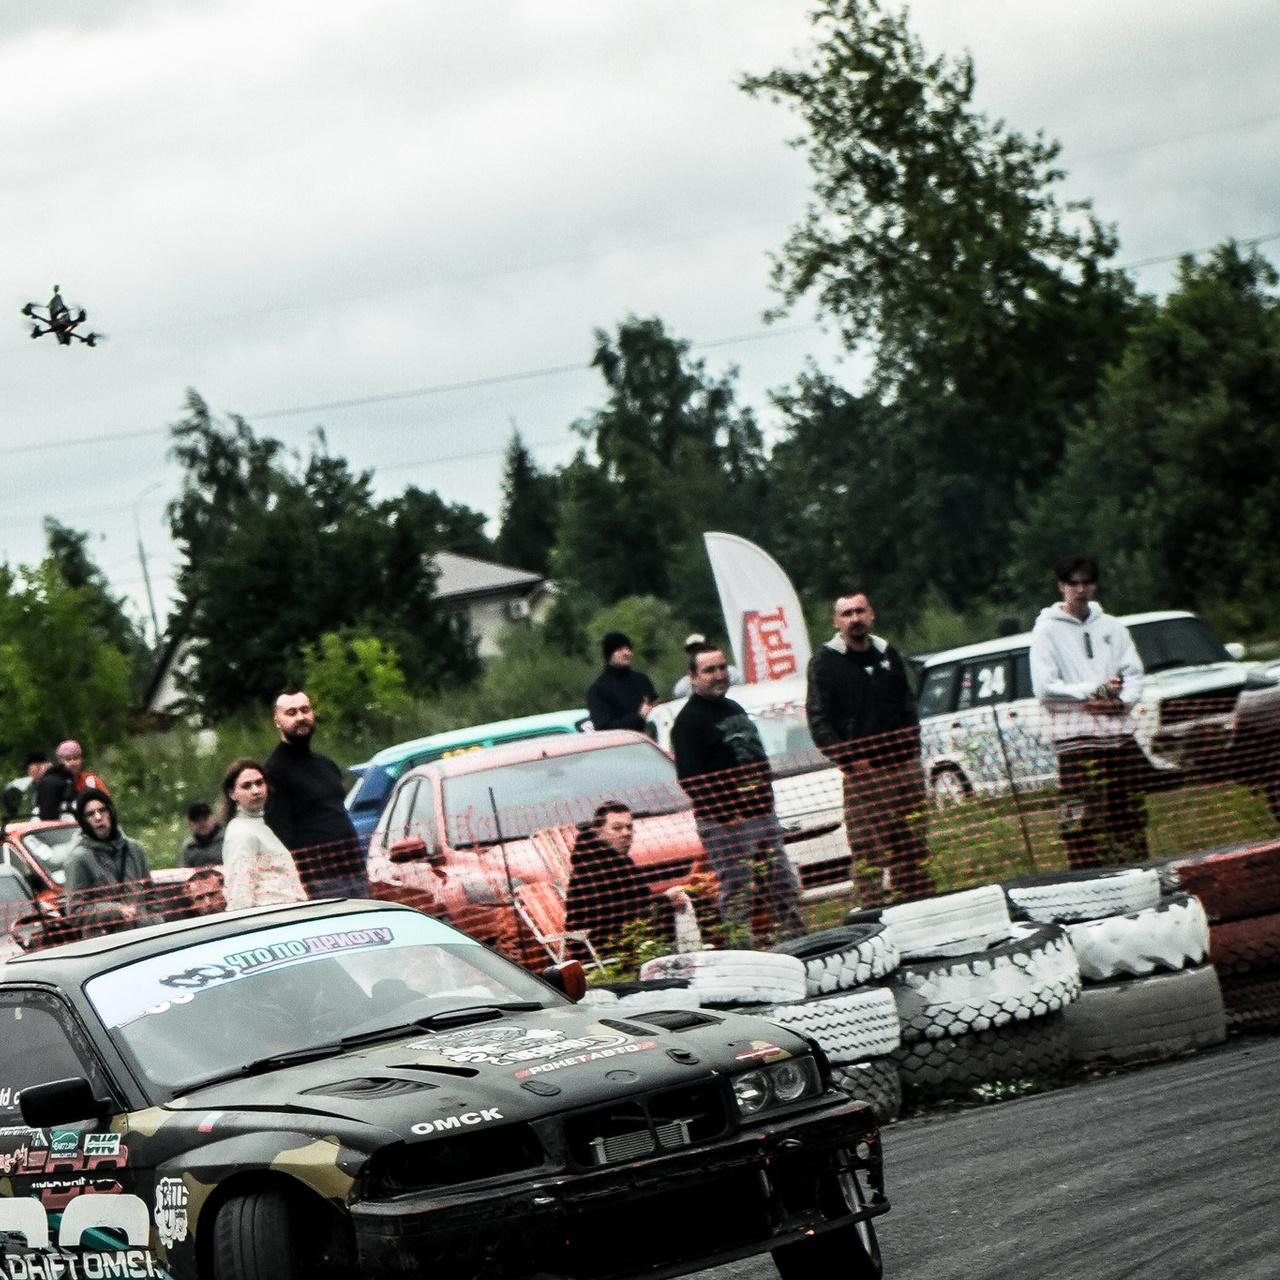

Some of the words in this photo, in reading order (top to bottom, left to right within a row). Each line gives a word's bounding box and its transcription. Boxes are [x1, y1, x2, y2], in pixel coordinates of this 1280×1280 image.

[977, 665, 1007, 699] 24
[224, 947, 273, 969] ЧТО
[274, 940, 309, 957] ПО
[305, 927, 395, 955] ДРИФТУ
[6, 1250, 79, 1280] DRIFT
